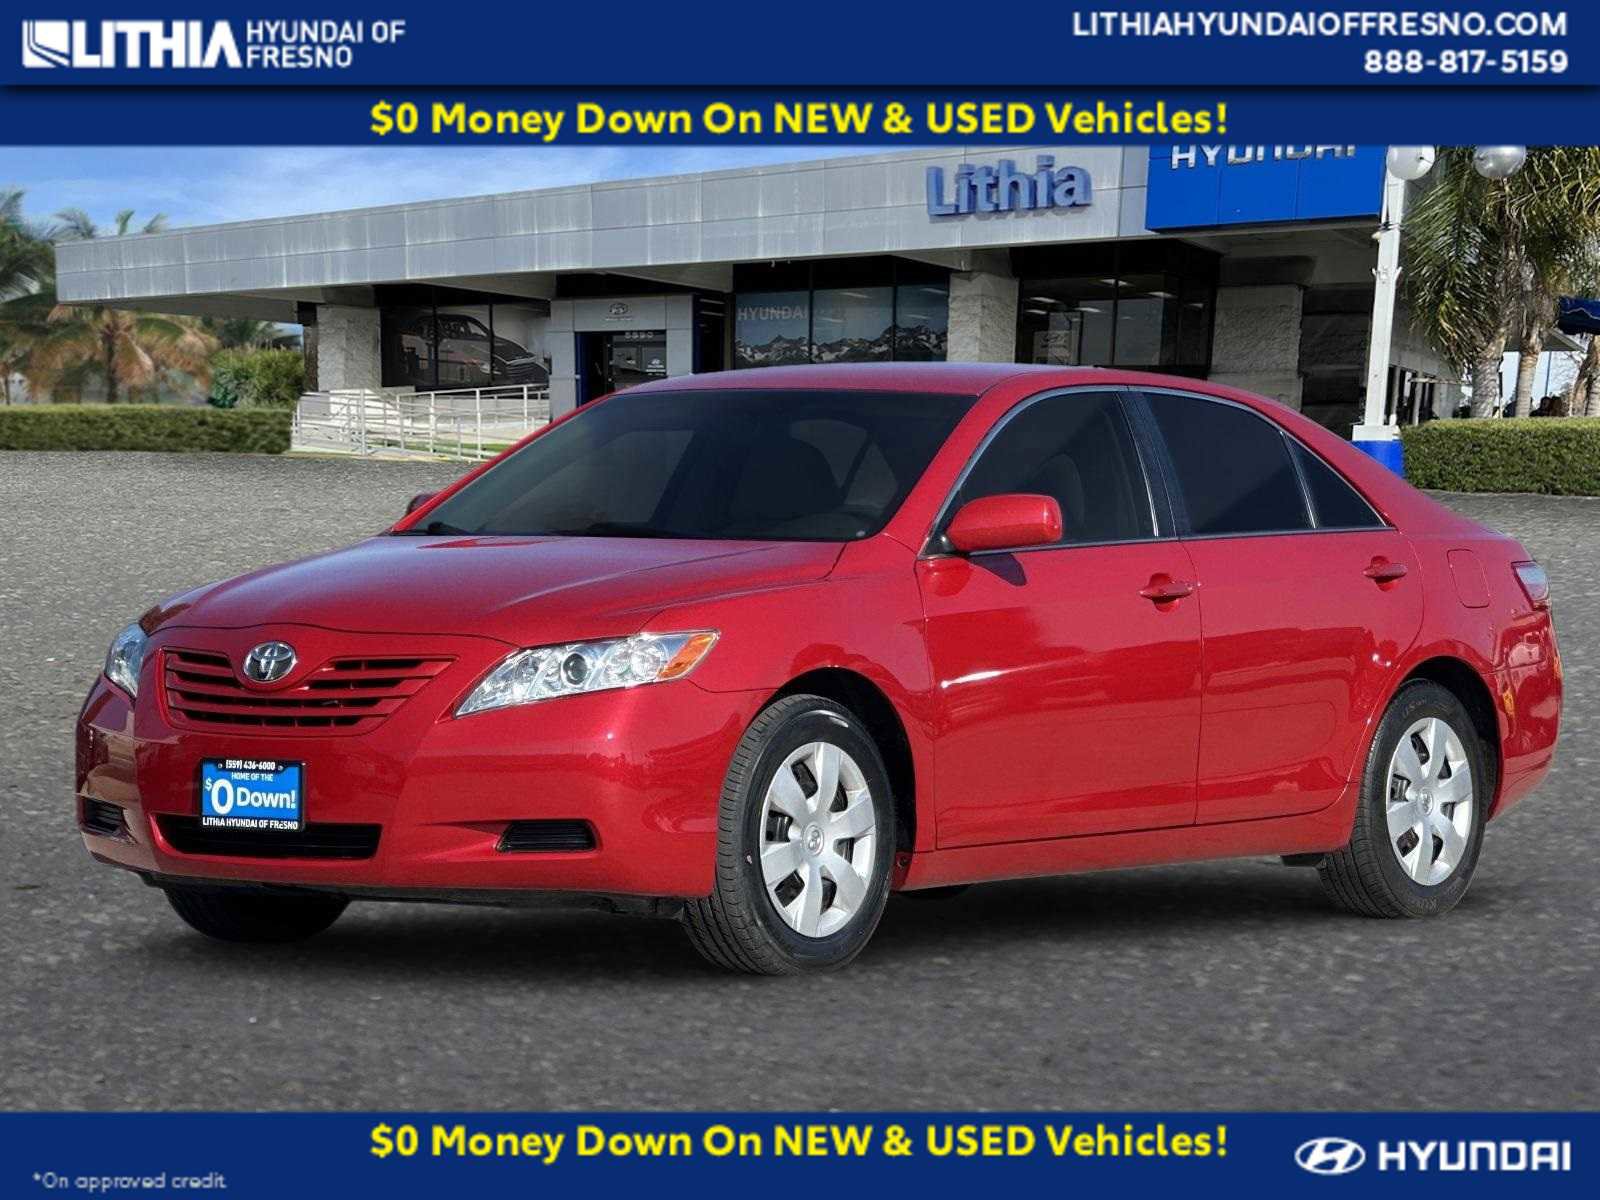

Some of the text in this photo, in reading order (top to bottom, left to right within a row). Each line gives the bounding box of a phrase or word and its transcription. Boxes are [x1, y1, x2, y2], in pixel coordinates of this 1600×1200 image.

[926, 155, 1093, 216] Lithia
[737, 306, 809, 321] HYUNDAI
[231, 771, 274, 782] HOME OF THE
[236, 786, 297, 809] Down!
[202, 816, 299, 830] LITHIA HYUNDAI OF FRESNO
